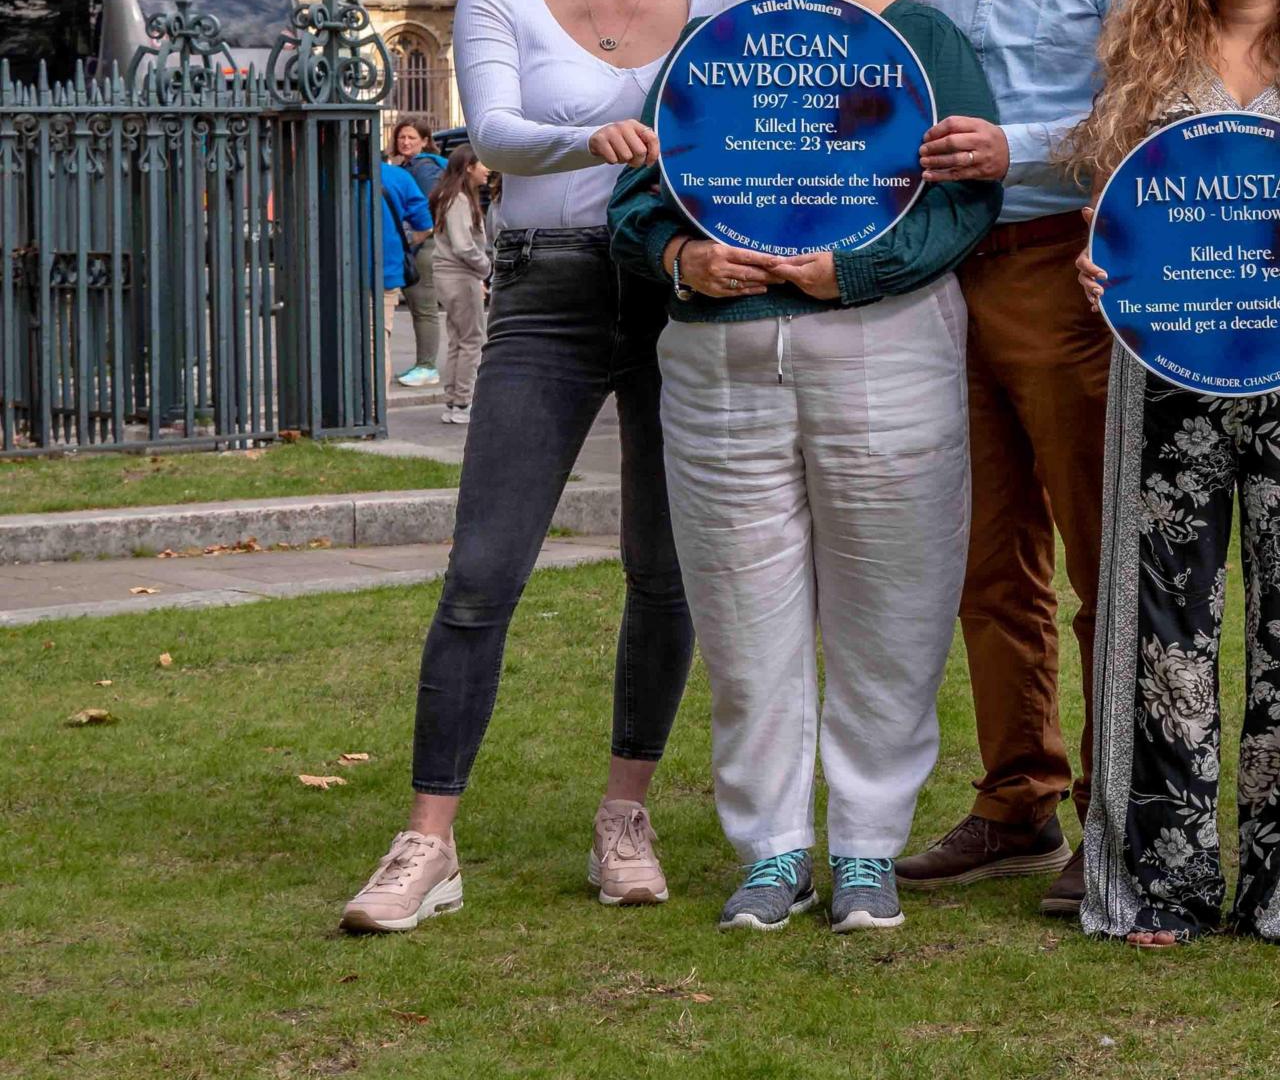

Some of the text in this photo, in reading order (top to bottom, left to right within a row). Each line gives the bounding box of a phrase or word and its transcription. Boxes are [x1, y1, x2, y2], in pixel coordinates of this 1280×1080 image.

[743, 33, 848, 58] MEGAN
[688, 62, 903, 88] NEWBOROUGH
[753, 94, 788, 108] 1997
[802, 94, 839, 109] 2021
[755, 118, 837, 133] Killed here.
[725, 136, 866, 154] Sentence: 23 years
[681, 173, 910, 187] The same murder outside the home
[712, 191, 878, 208] would get a decade more.
[1136, 176, 1186, 206] JAN
[1168, 207, 1205, 222] 1980
[1191, 245, 1275, 261] Killed here.
[1163, 266, 1235, 280] Sentence:
[1240, 263, 1257, 278] 19
[1117, 300, 1142, 313] The
[1145, 303, 1180, 312] same
[1184, 298, 1233, 311] murder
[1150, 317, 1191, 331] would
[1195, 320, 1216, 334] get
[1219, 321, 1227, 330] a
[1230, 315, 1278, 329] decade
[1154, 354, 1192, 380] MURDER
[1192, 371, 1200, 381] IS
